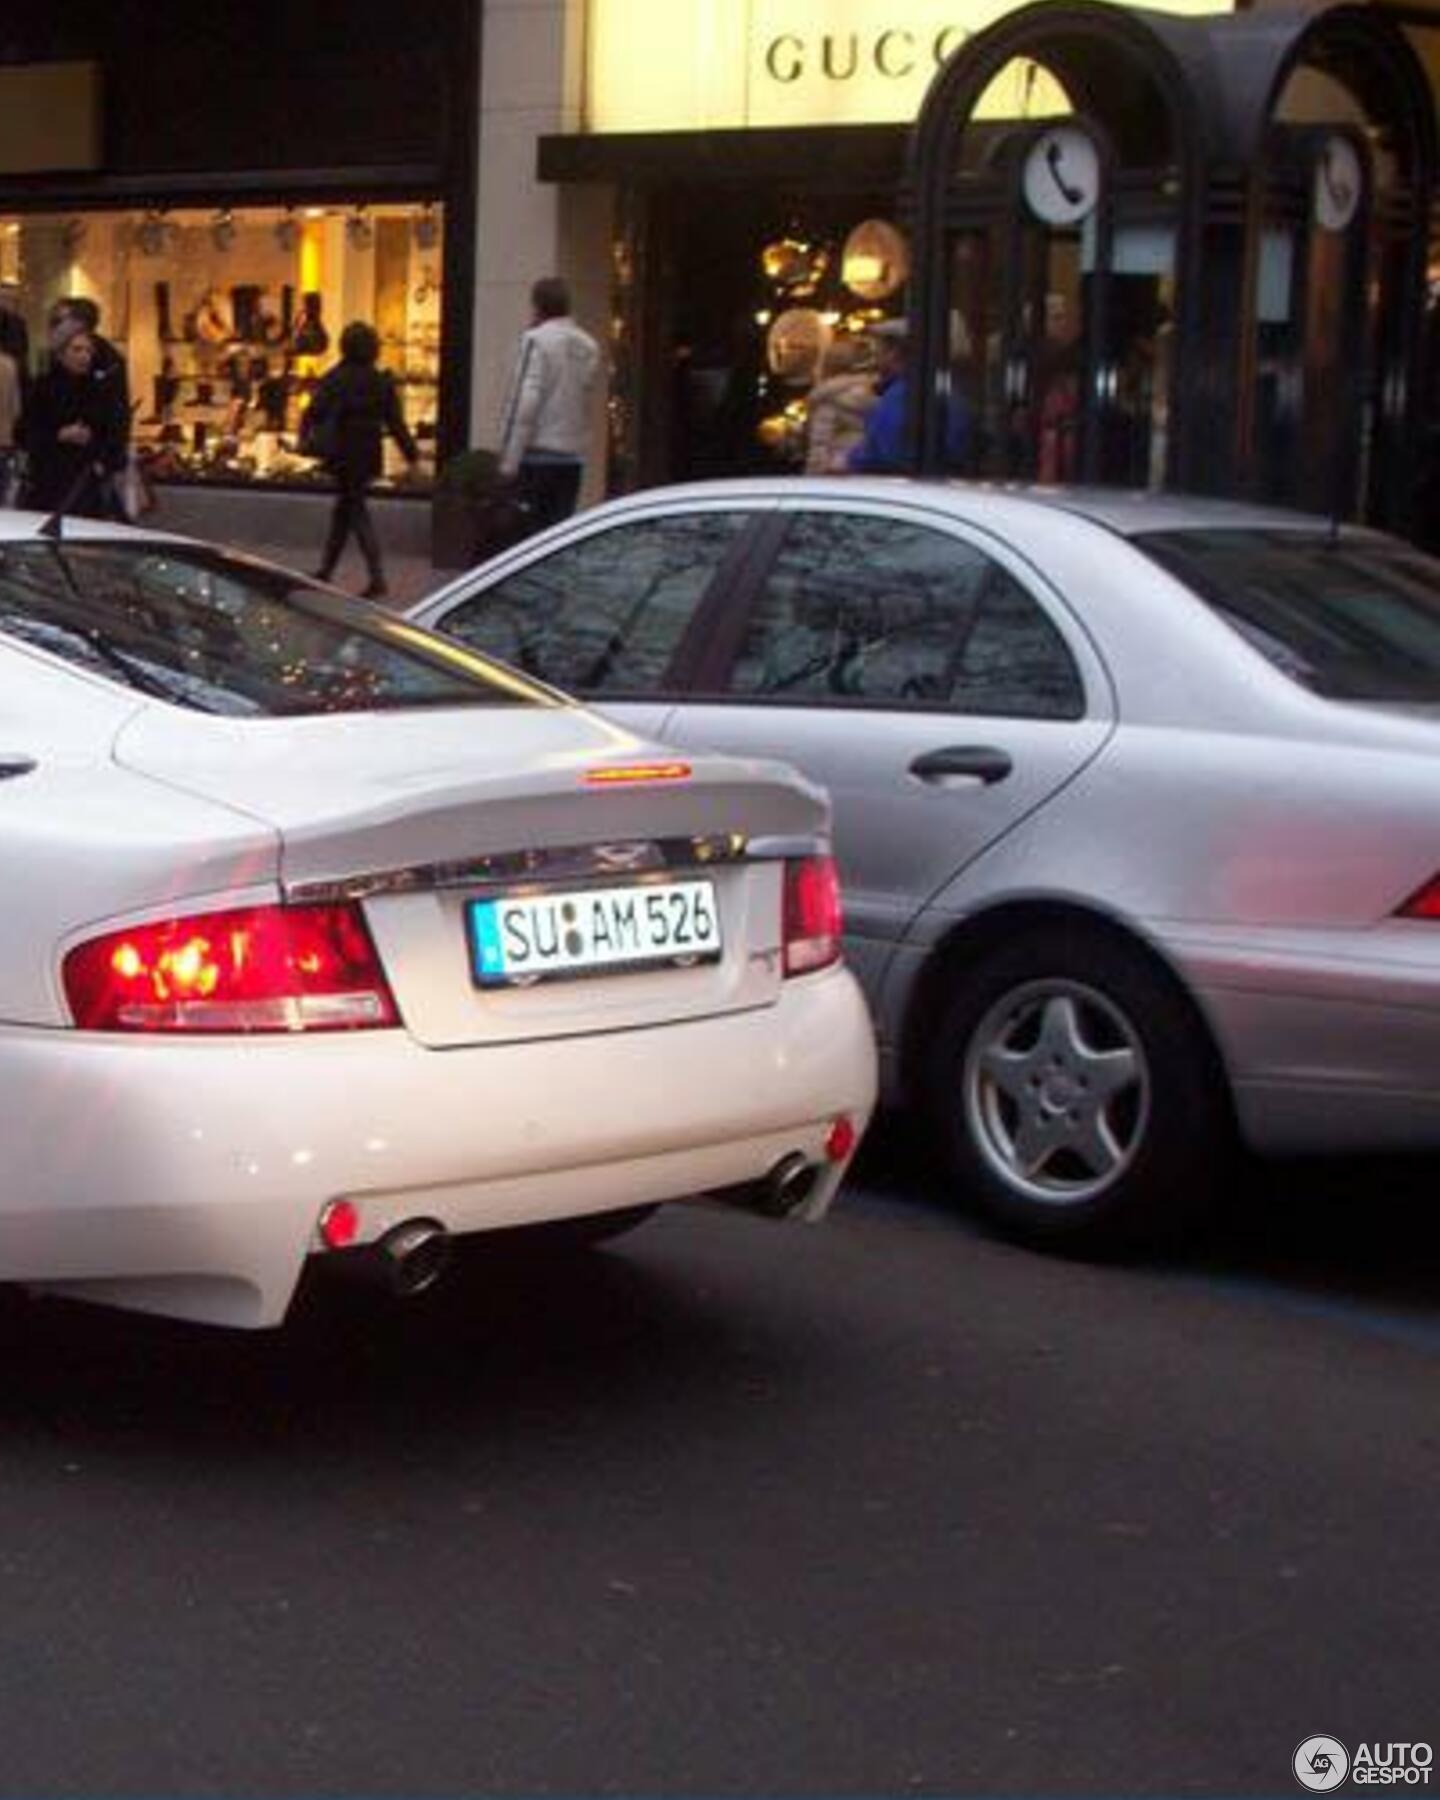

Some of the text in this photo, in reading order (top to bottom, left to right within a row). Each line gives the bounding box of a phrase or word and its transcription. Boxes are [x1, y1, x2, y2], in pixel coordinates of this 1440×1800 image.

[765, 26, 975, 84] GUCC
[503, 889, 711, 962] SU AM 526
